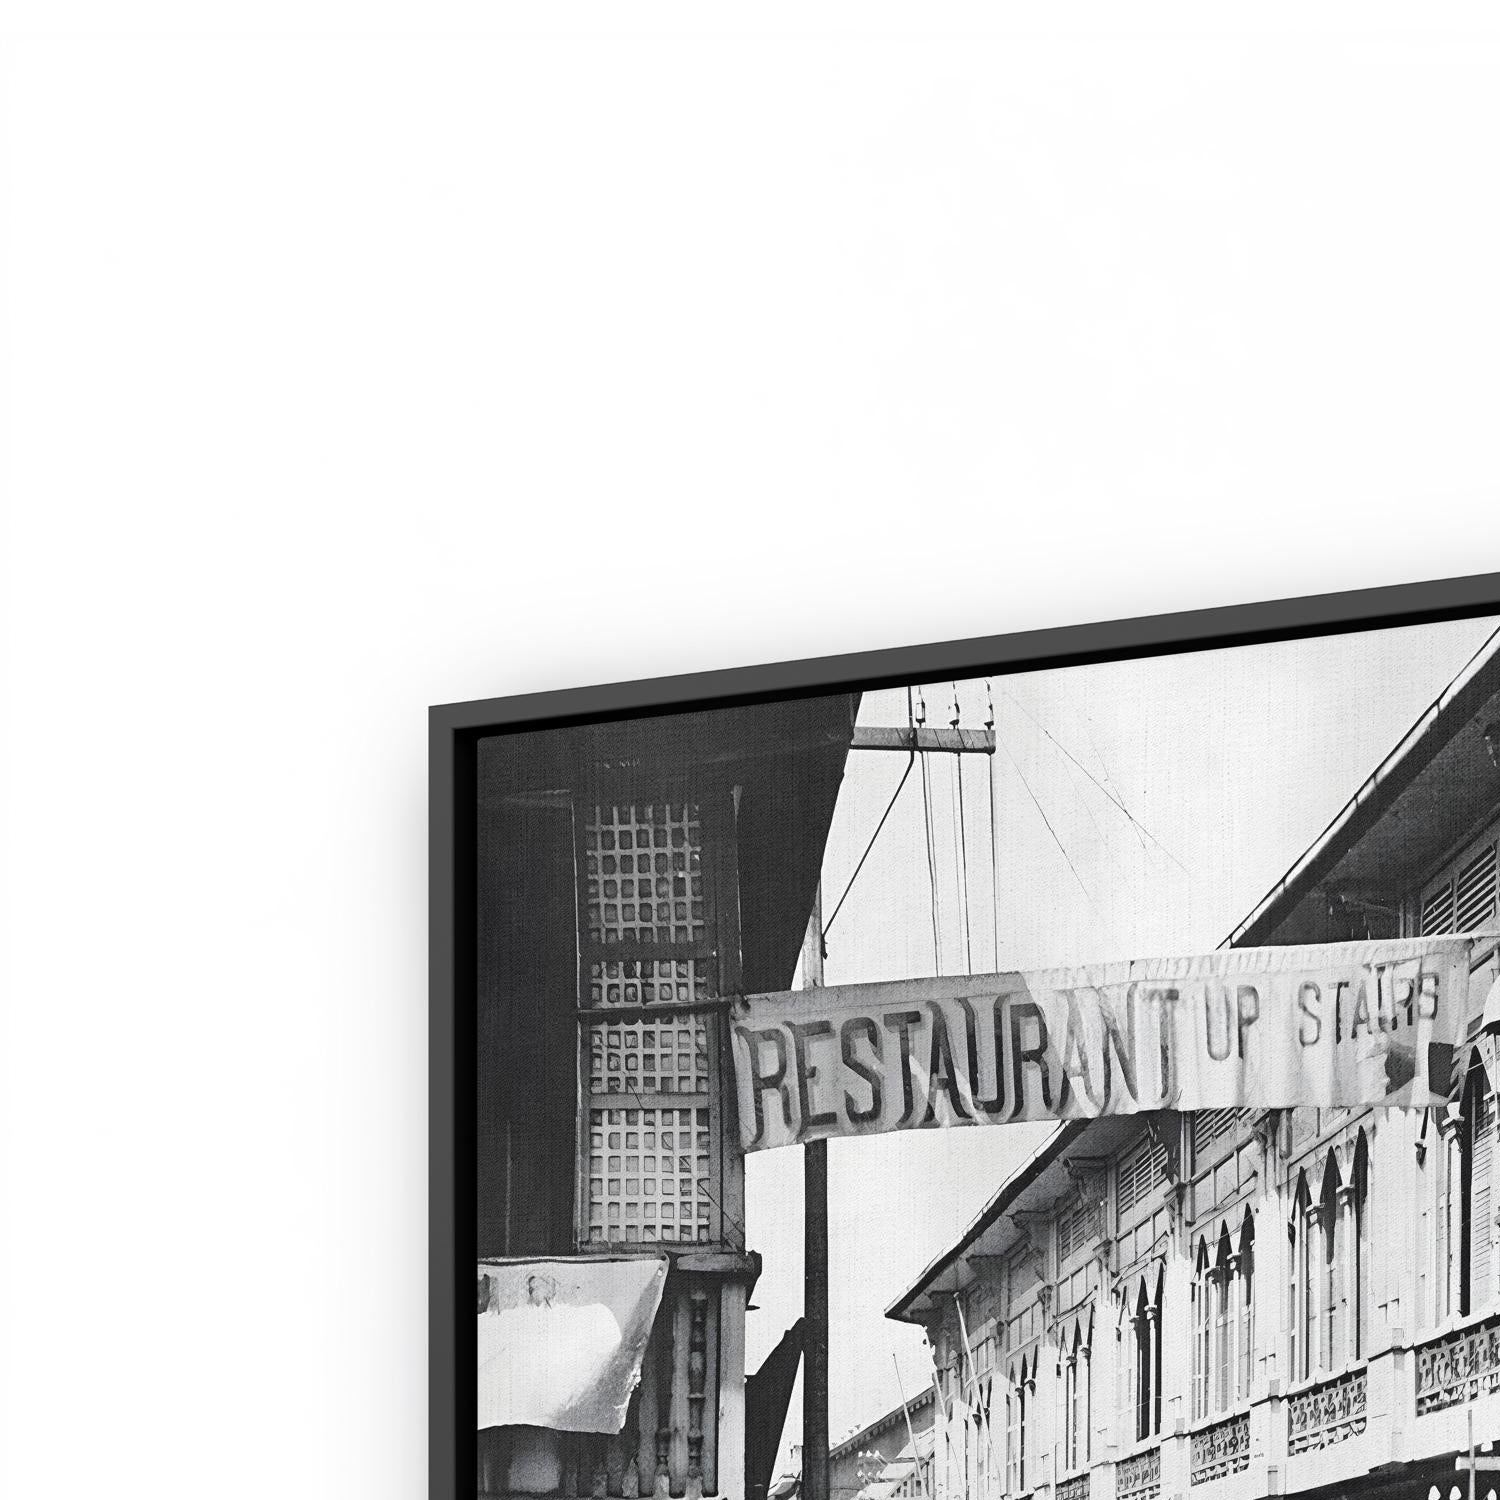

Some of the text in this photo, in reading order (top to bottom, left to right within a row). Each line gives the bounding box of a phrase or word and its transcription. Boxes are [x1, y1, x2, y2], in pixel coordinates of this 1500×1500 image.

[735, 965, 1439, 1147] RESTAURANT UP STAIRS
